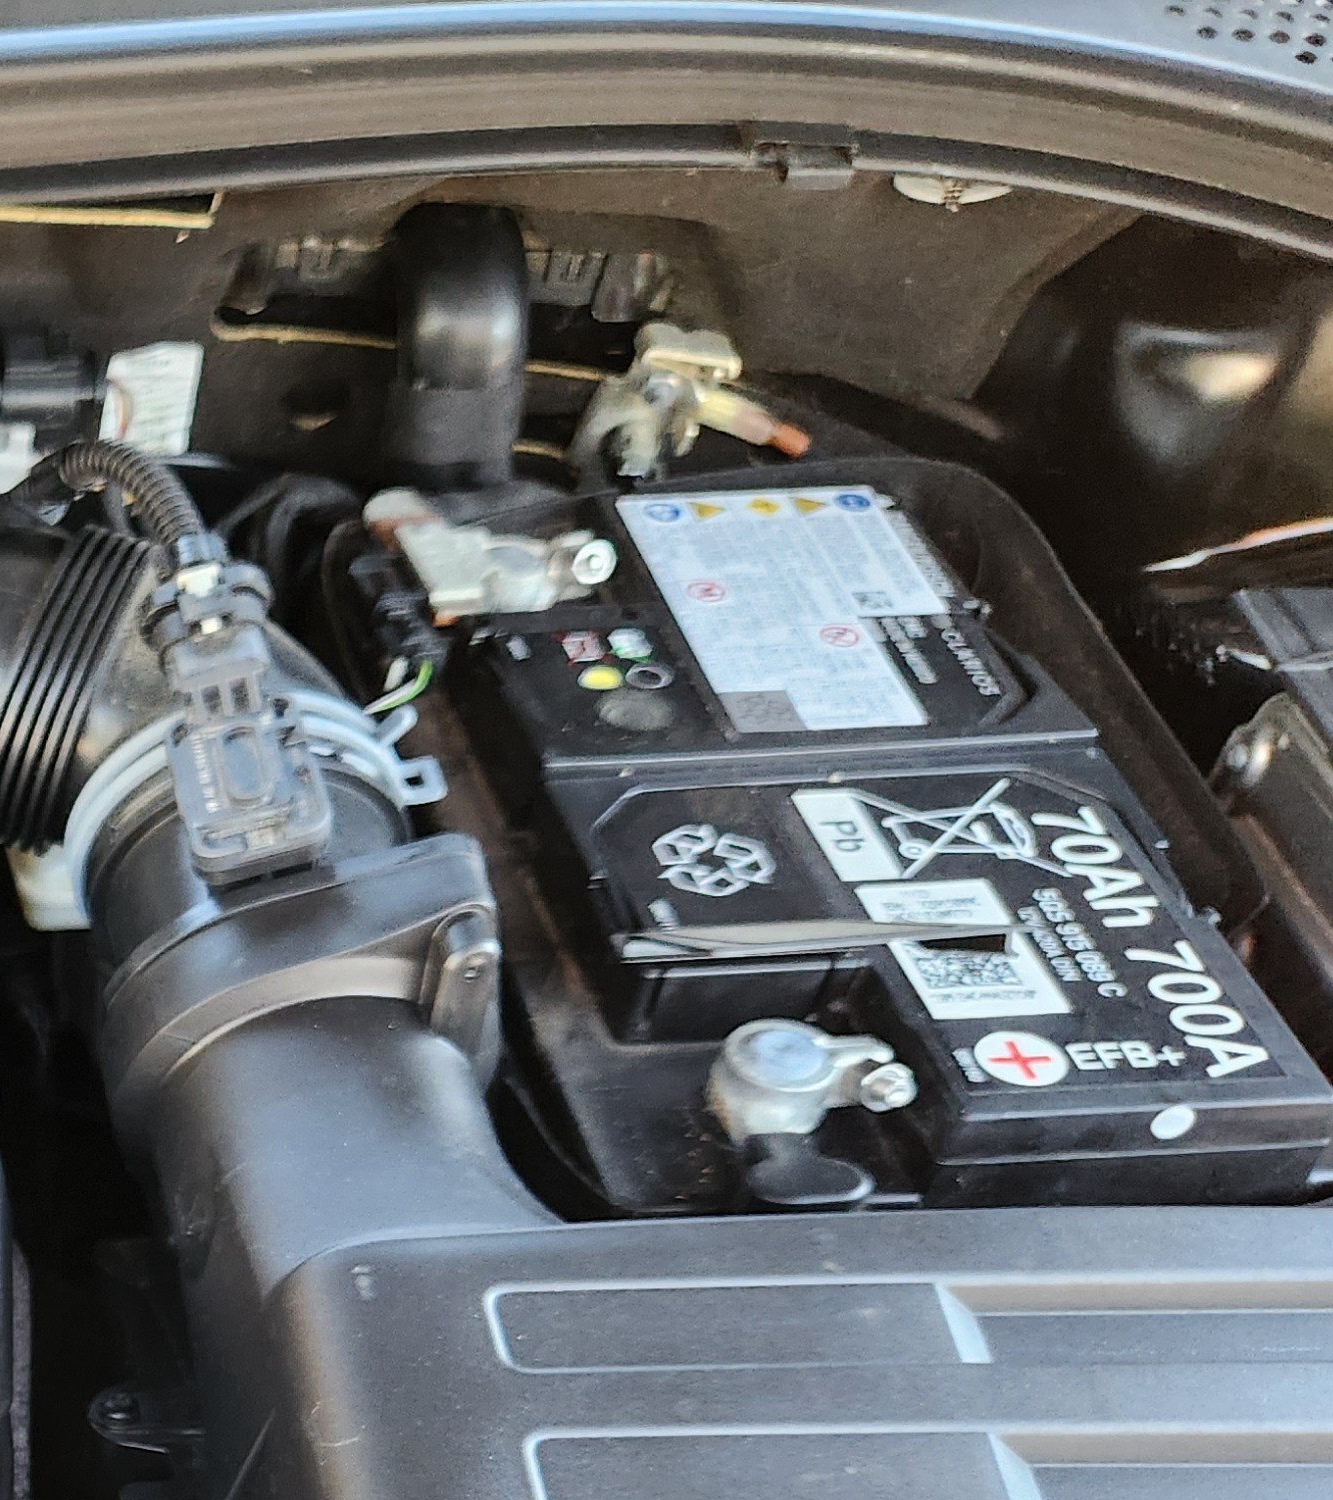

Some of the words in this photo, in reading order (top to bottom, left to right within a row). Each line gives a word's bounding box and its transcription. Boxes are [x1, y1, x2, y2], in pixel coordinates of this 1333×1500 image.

[820, 819, 865, 852] Pb
[1031, 806, 1160, 928] 70Ah
[1124, 939, 1270, 1078] 700A
[1056, 921, 1096, 951] 915
[1097, 982, 1129, 998] C
[1065, 1039, 1186, 1072] EFB+
